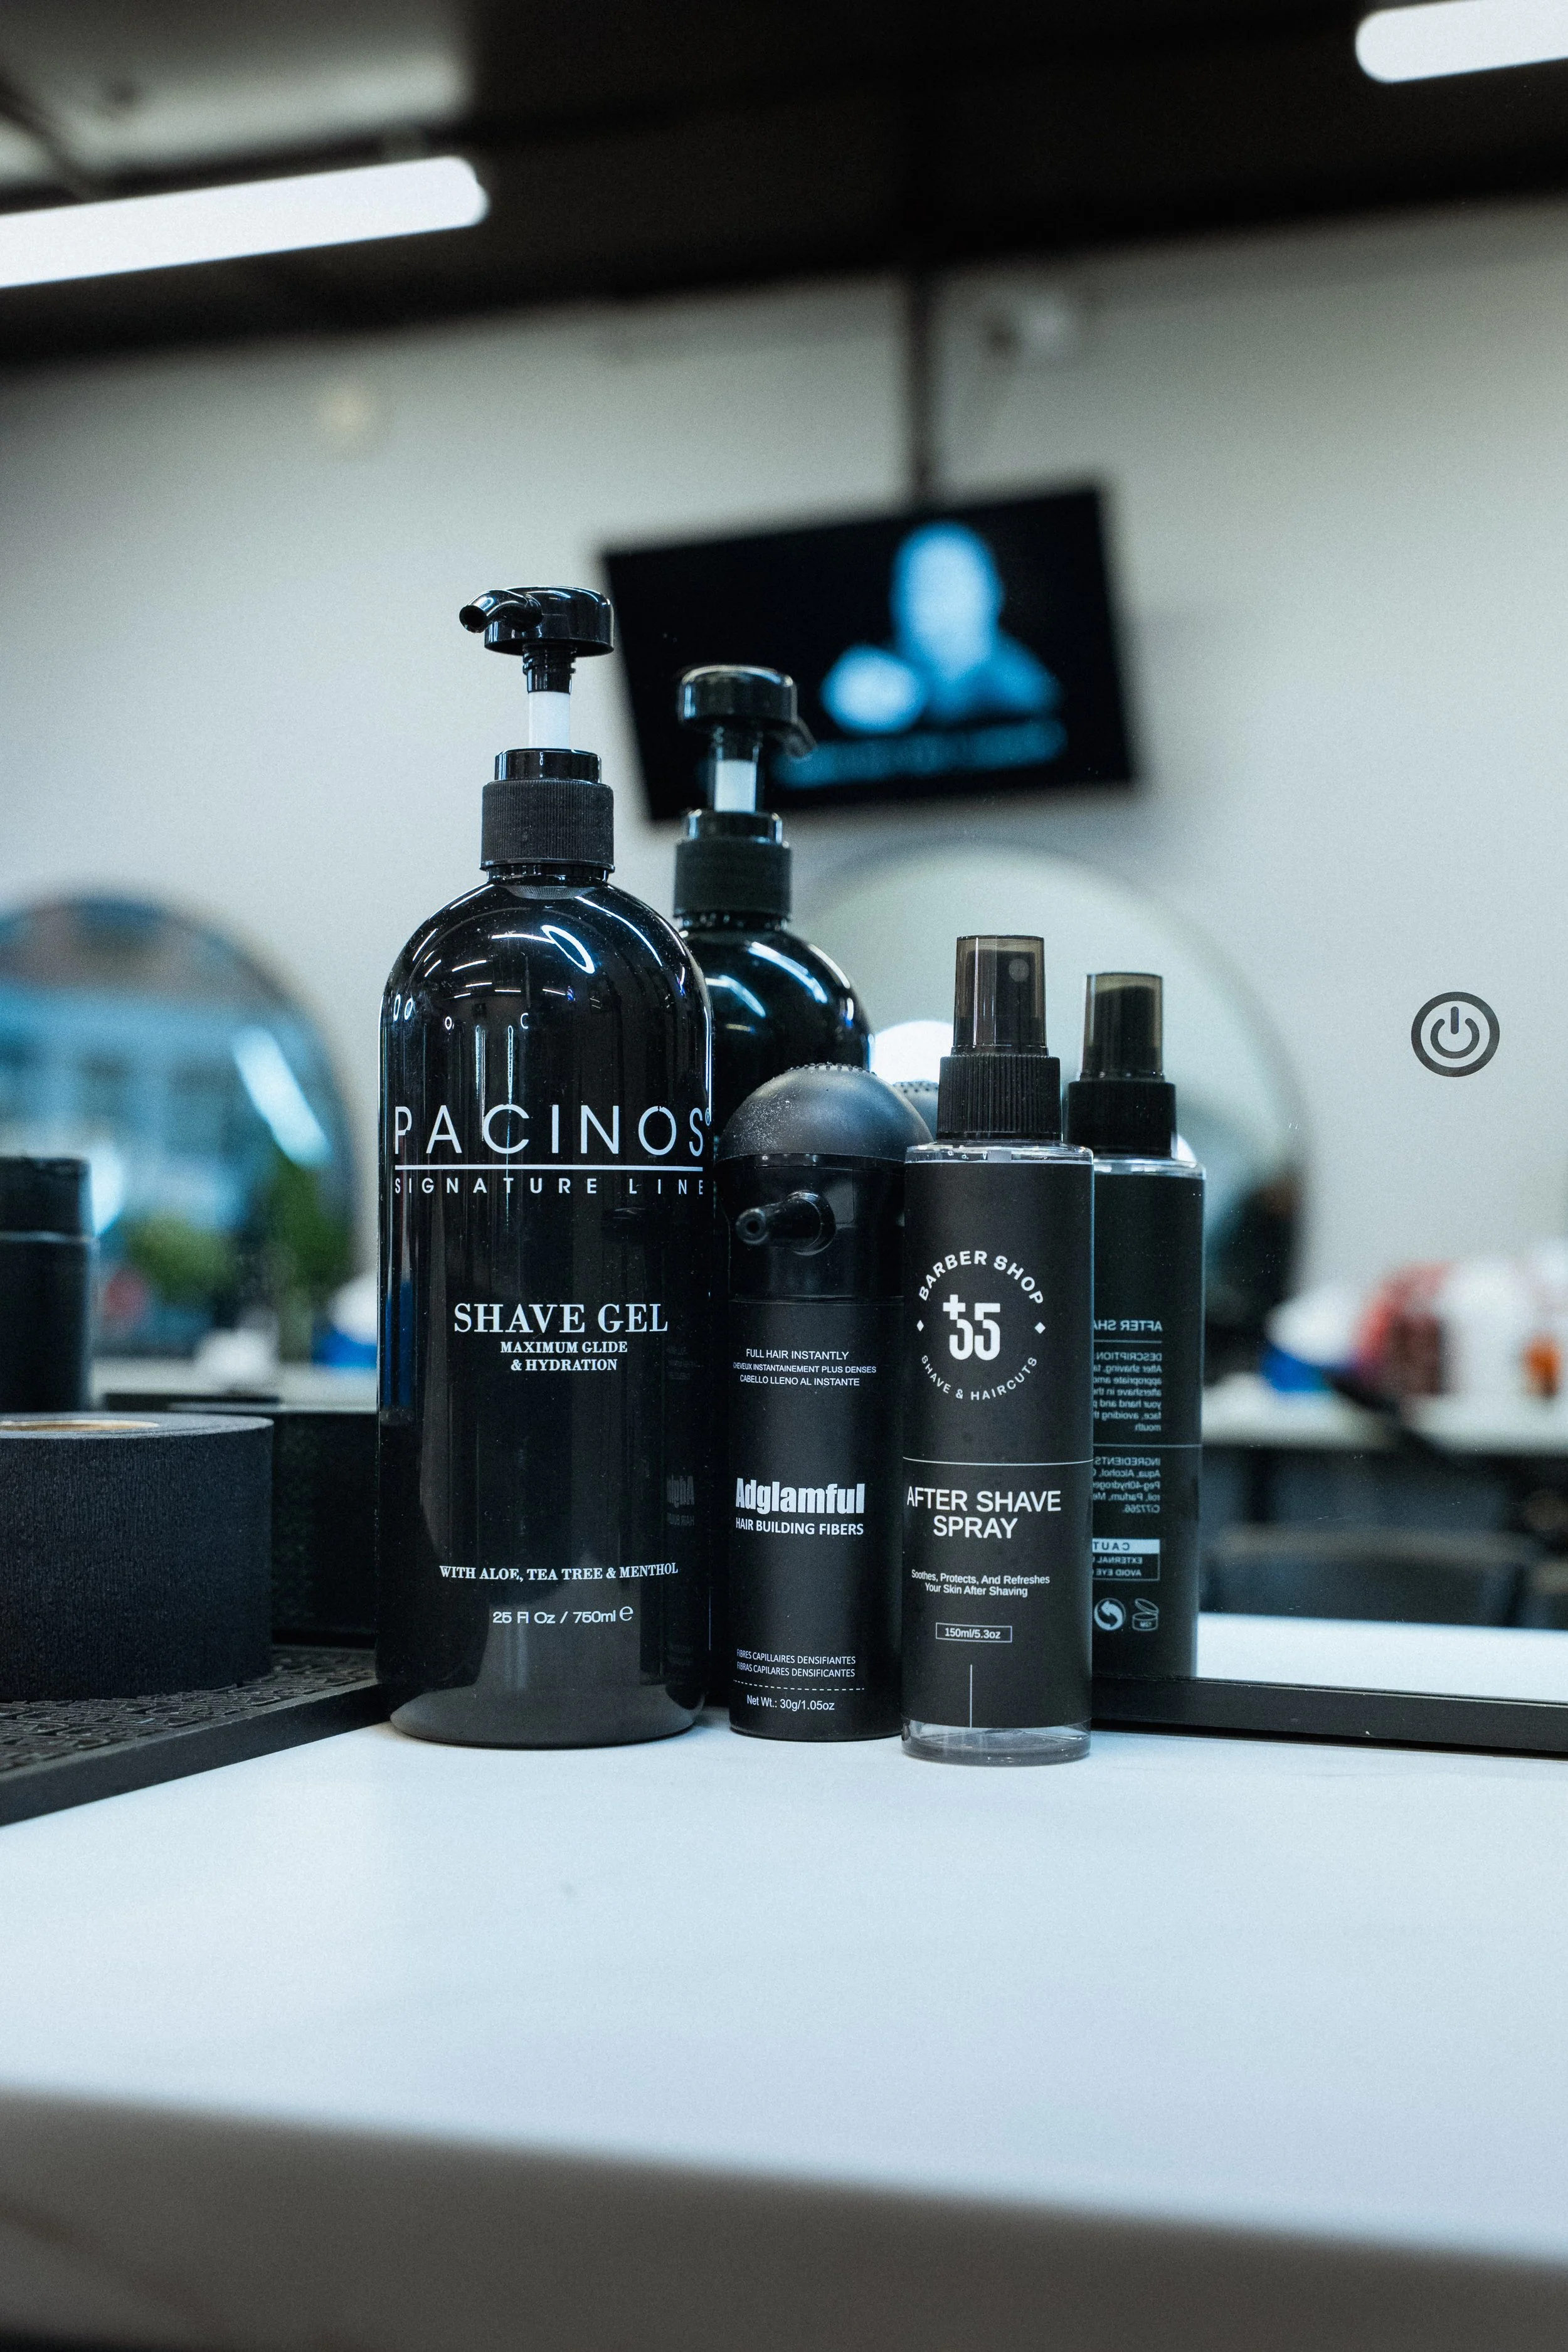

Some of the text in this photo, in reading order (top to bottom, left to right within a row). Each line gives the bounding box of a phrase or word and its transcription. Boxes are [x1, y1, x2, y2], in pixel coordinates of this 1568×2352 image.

[395, 1177, 702, 1194] SIGNATURE LINE
[919, 1251, 1043, 1303] BARBER SHOP
[455, 1303, 667, 1333] SHAVE GEL
[501, 1342, 627, 1353] MAXIMUM GLIDE
[746, 1348, 849, 1360] FULL HAIR INSTANTLY
[511, 1359, 617, 1370] & HYDRATION
[753, 1364, 820, 1372] INSTANTAINEMENT
[740, 1375, 768, 1384] CABELLO
[771, 1377, 798, 1385] LLENO
[922, 1355, 1037, 1400] SHAVE & HAIRCUTS
[736, 1478, 864, 1514] Adglamful
[907, 1486, 1061, 1512] AFTER SHAVE
[736, 1518, 863, 1535] HAIR BUILDING FIBERS
[933, 1515, 1017, 1539] SPRAY
[440, 1563, 678, 1582] WITH ALOE, TEA TREE & MENTHOL
[912, 1569, 1050, 1584] Soothes, Protects, And Refreshes
[925, 1582, 1027, 1597] Your Skin After Shaving
[493, 1612, 512, 1623] 25
[517, 1611, 529, 1623] Fl
[534, 1612, 555, 1623] Oz
[560, 1611, 568, 1623] /
[573, 1610, 615, 1623] 750ml
[945, 1628, 1000, 1639] 150ml/5.3oz
[738, 1649, 856, 1664] FIBRES CAPILLAIRES DENSIFIANTES
[738, 1661, 855, 1677] FIBRAS CAPILARES DENSIFICANTES
[748, 1695, 834, 1711] Net Wt.: 30g/1.05oz
